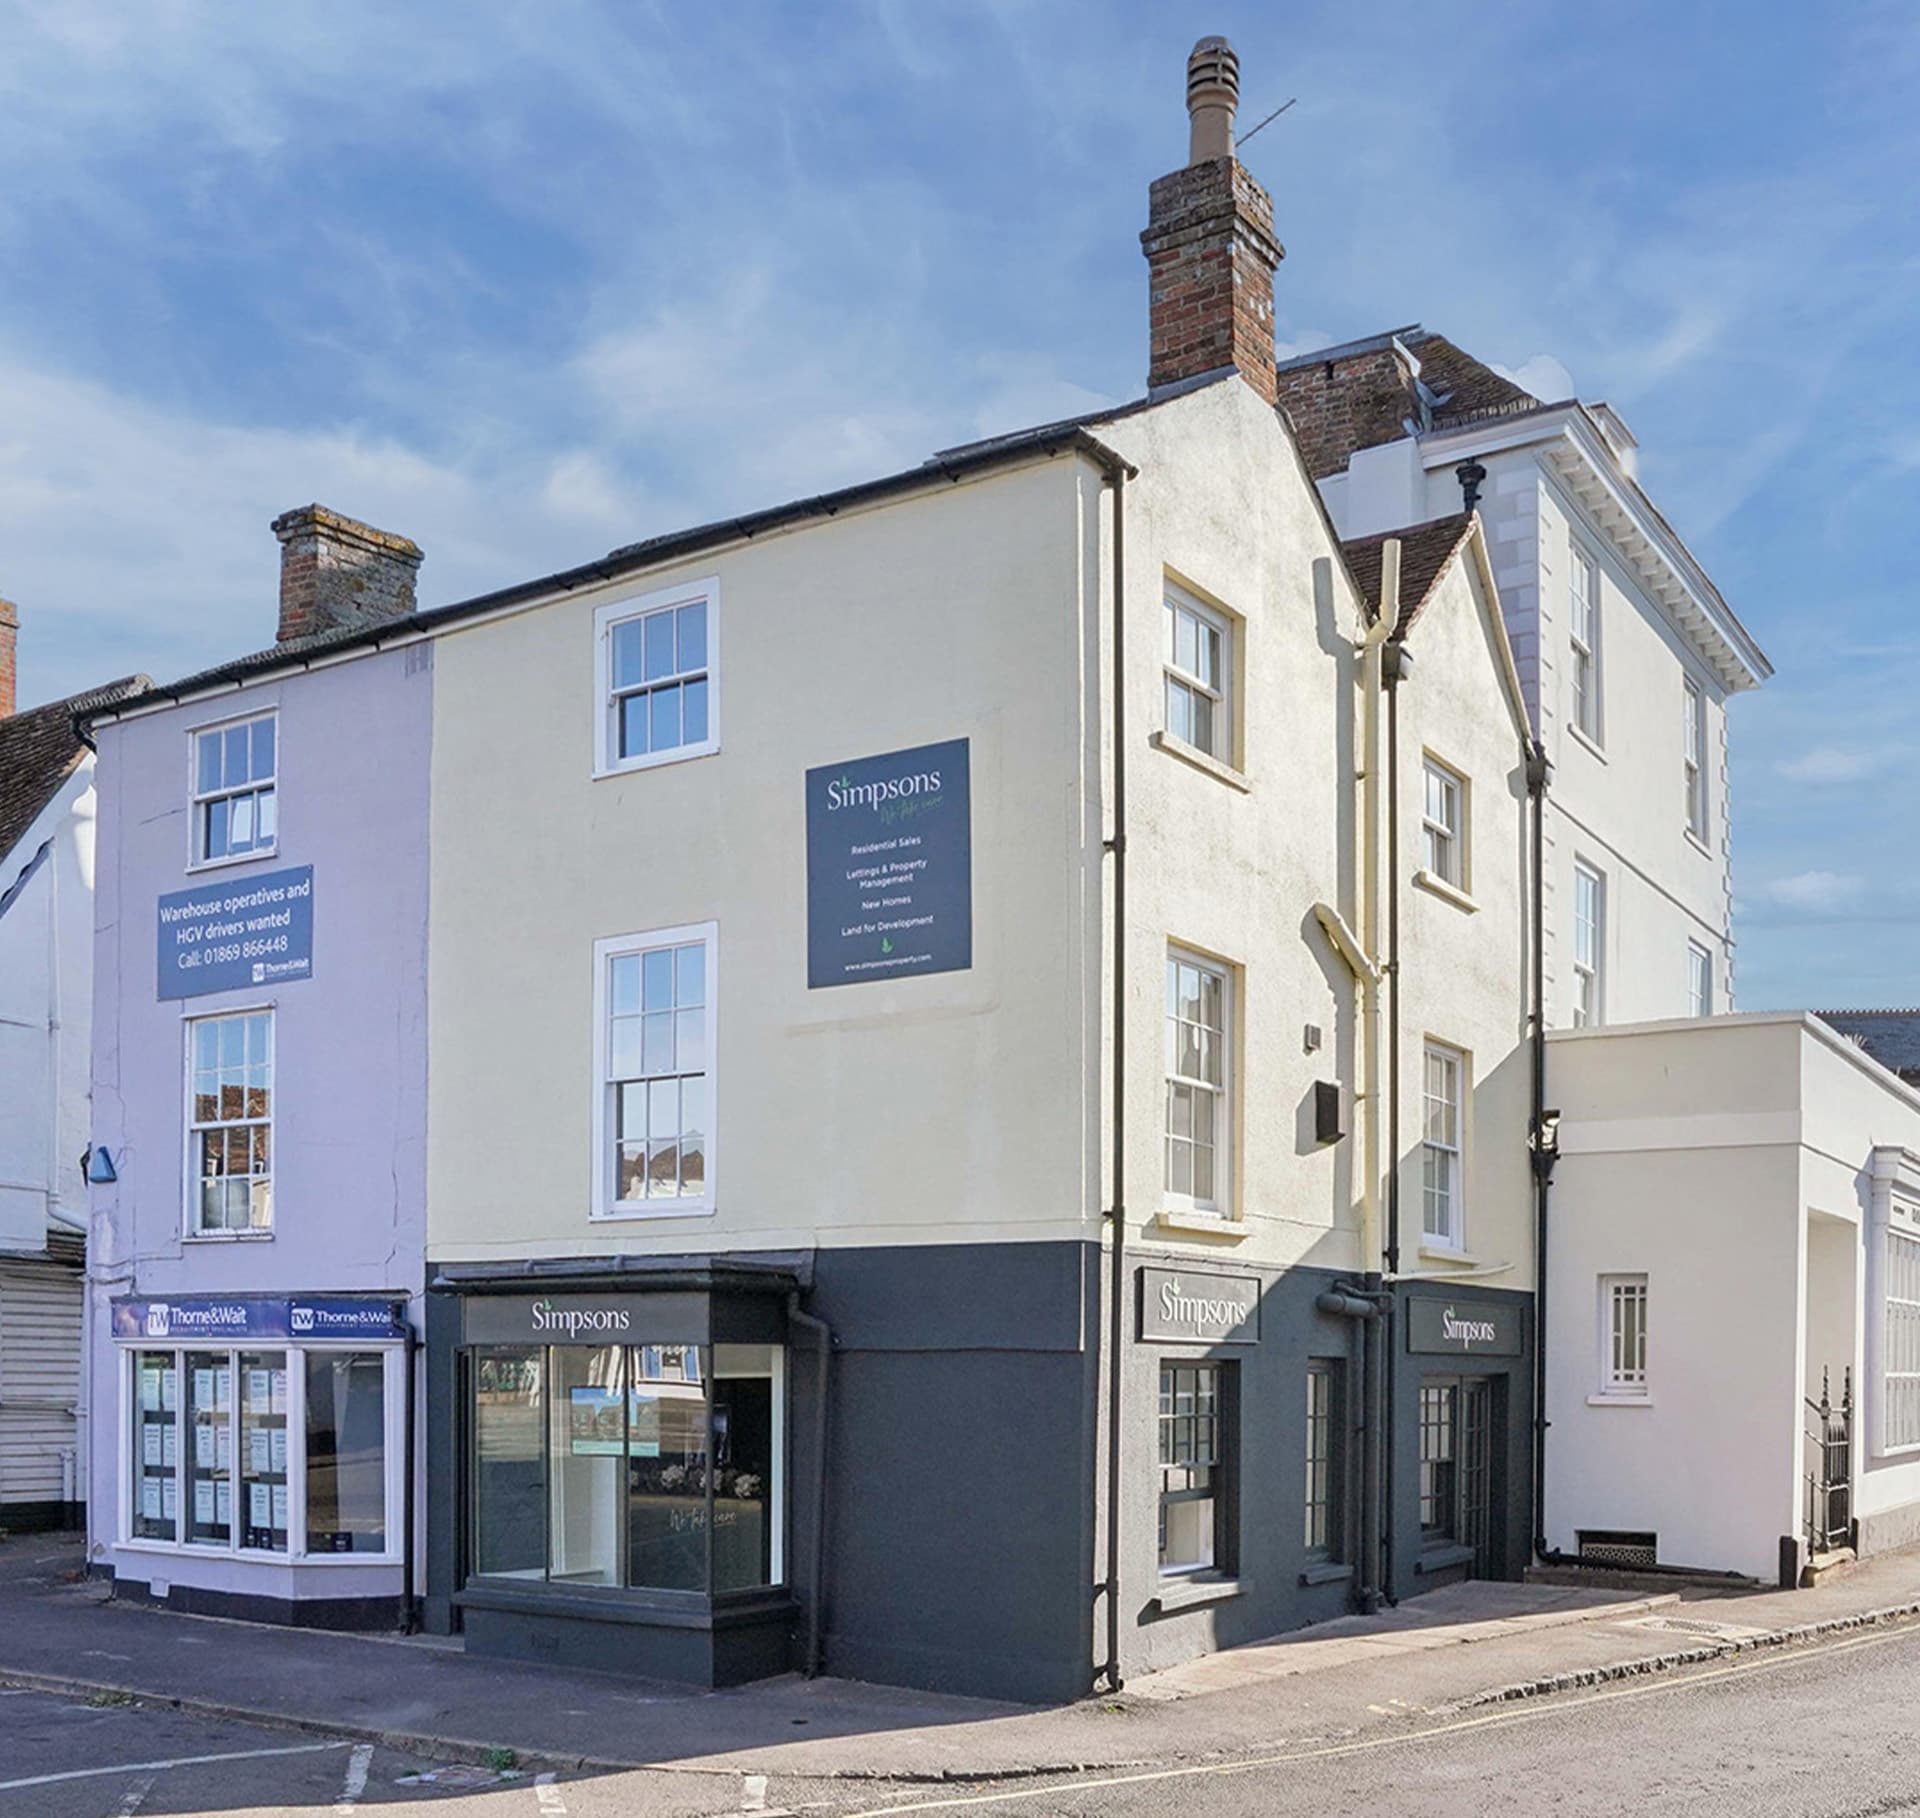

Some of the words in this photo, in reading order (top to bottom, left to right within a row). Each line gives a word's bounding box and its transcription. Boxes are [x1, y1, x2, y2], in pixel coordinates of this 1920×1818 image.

[828, 770, 941, 811] Simpsons
[851, 838, 897, 855] Residential
[898, 836, 921, 848] Sales
[846, 866, 880, 880] Lettings
[881, 864, 889, 874] &
[889, 859, 928, 872] Property
[860, 873, 914, 889] Management
[160, 901, 222, 922] Warehouse
[224, 886, 284, 914] operatives
[287, 879, 310, 899] and
[861, 900, 881, 911] New
[882, 896, 912, 907] Homes
[177, 925, 203, 944] HGV
[205, 921, 244, 940] drivers
[247, 908, 291, 932] wanted
[841, 924, 862, 937] Land
[863, 922, 876, 934] for
[877, 915, 933, 932] Development
[178, 949, 202, 969] Call:
[204, 944, 241, 965] 01869
[242, 935, 288, 958] 866448
[170, 1306, 247, 1325] Thorne&Wait
[315, 1310, 392, 1324] Thorne&Wai
[532, 1301, 630, 1339] Simpsons
[1159, 1280, 1246, 1336] Simpsons
[1442, 1309, 1495, 1349] Simpsons
